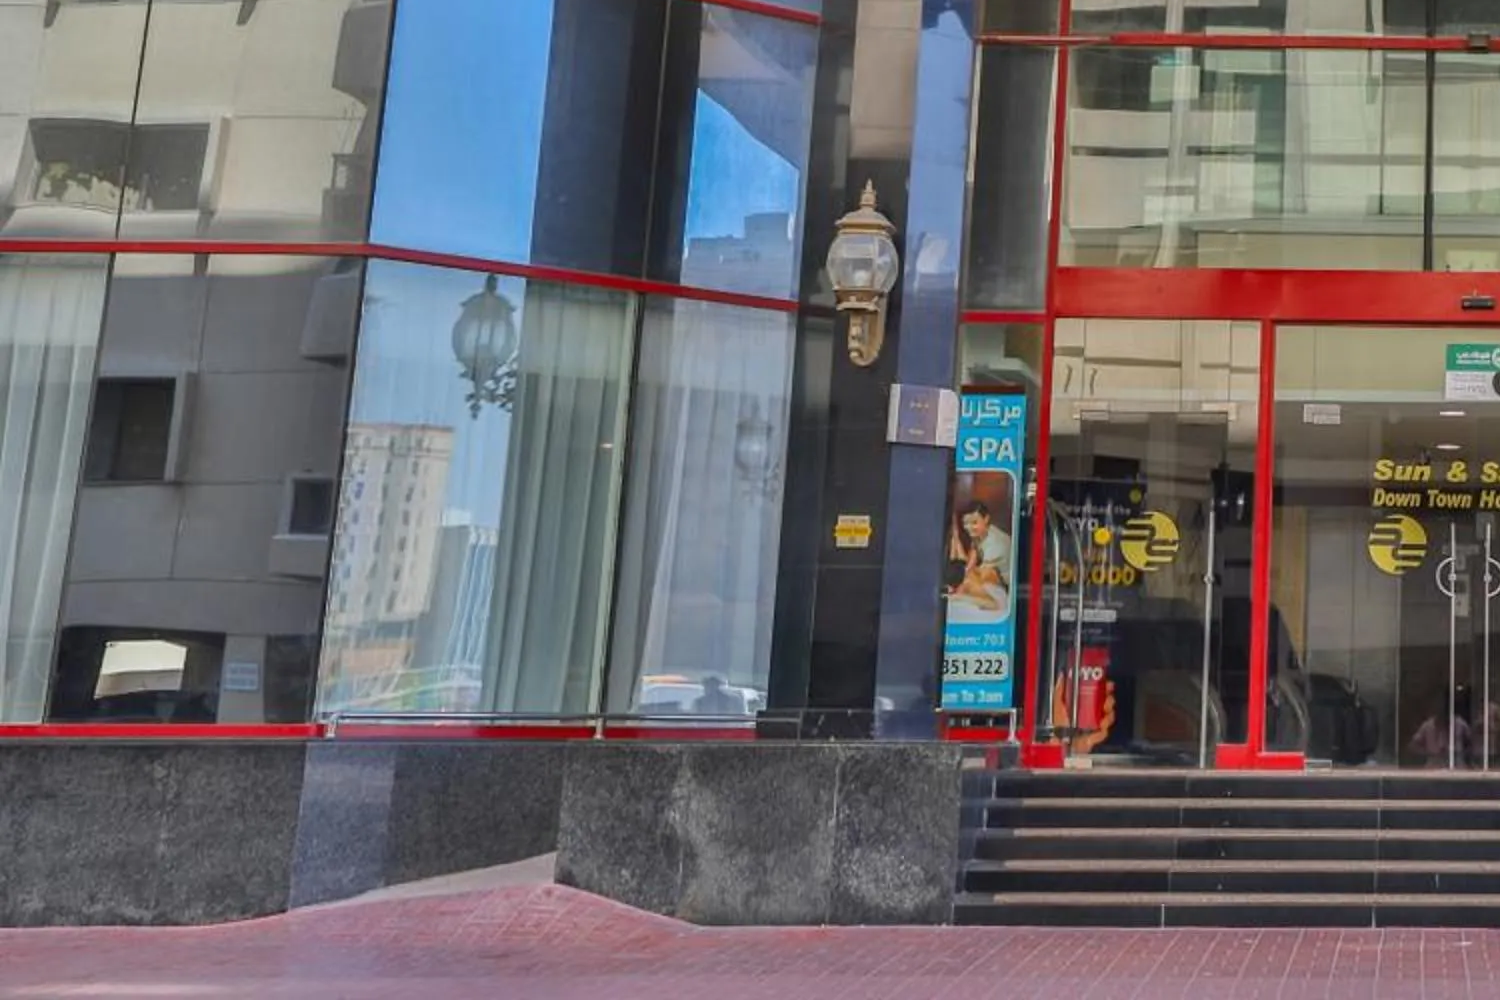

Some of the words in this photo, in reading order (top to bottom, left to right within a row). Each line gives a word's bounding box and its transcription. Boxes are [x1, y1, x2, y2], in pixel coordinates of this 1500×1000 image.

[963, 436, 1017, 462] SPA
[1373, 459, 1431, 482] Sun
[1446, 461, 1468, 483] &
[1372, 488, 1421, 507] Down
[1428, 489, 1472, 508] Town
[973, 659, 1004, 675] 222
